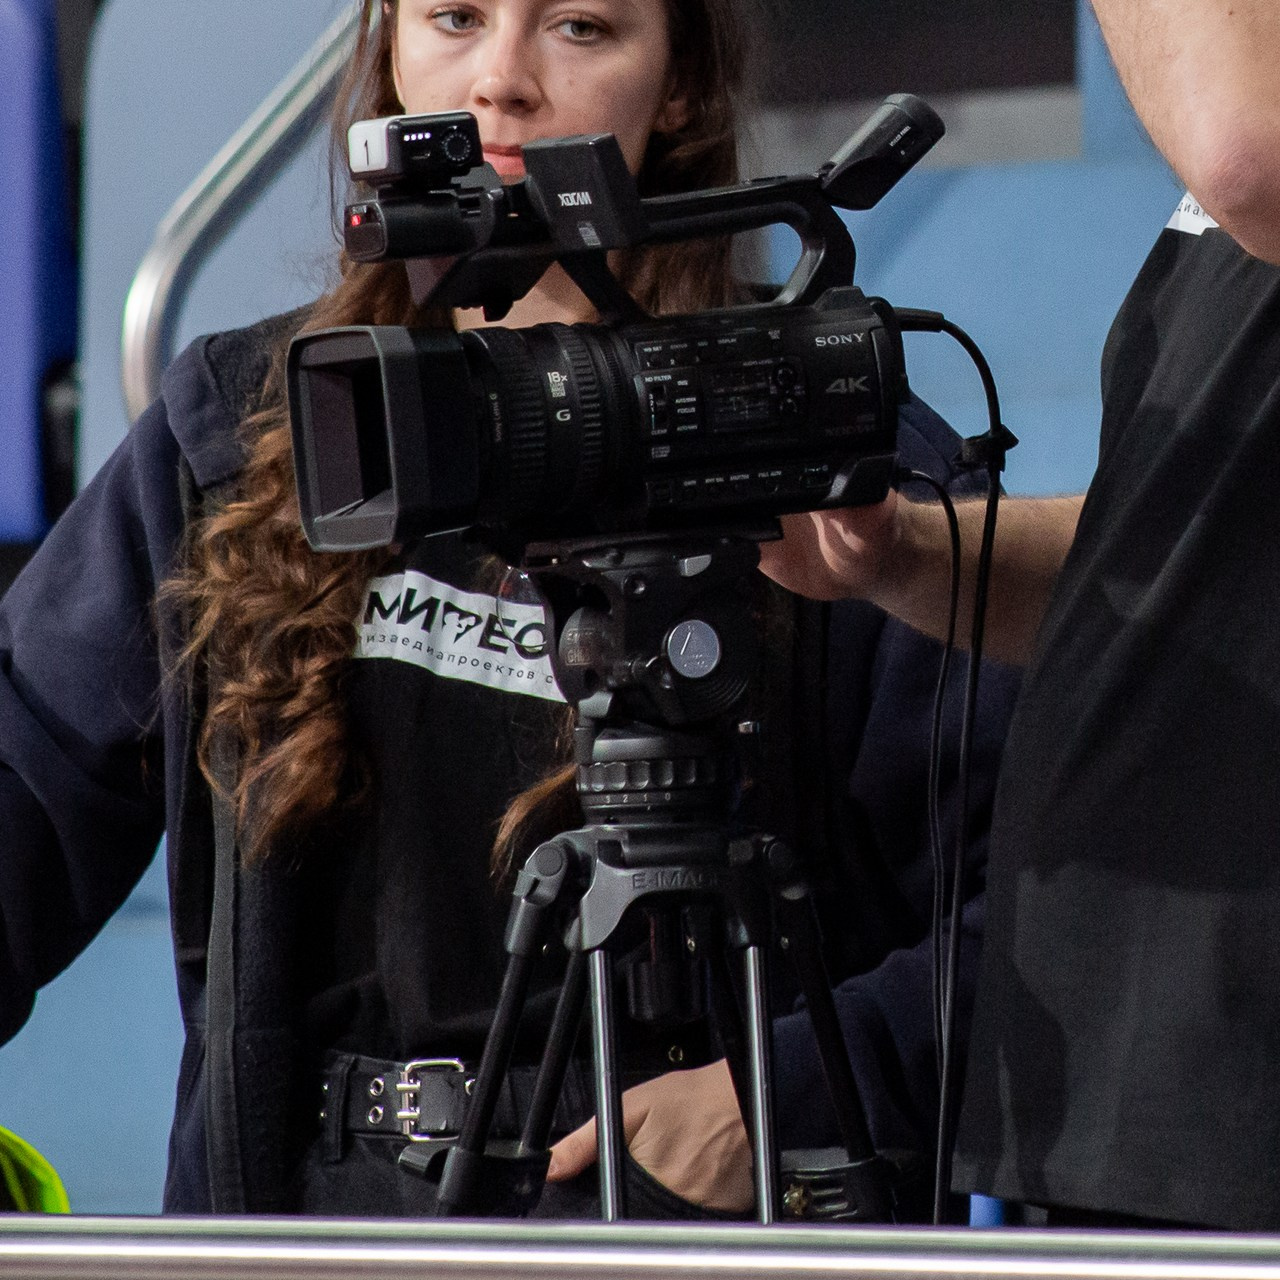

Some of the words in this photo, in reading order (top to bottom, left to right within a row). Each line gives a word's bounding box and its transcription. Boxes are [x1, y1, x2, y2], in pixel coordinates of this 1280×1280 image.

[815, 332, 865, 347] SONY
[547, 371, 568, 383] 18x
[825, 375, 870, 395] 4K
[556, 409, 571, 422] G
[622, 794, 629, 803] 2
[664, 792, 671, 801] 0
